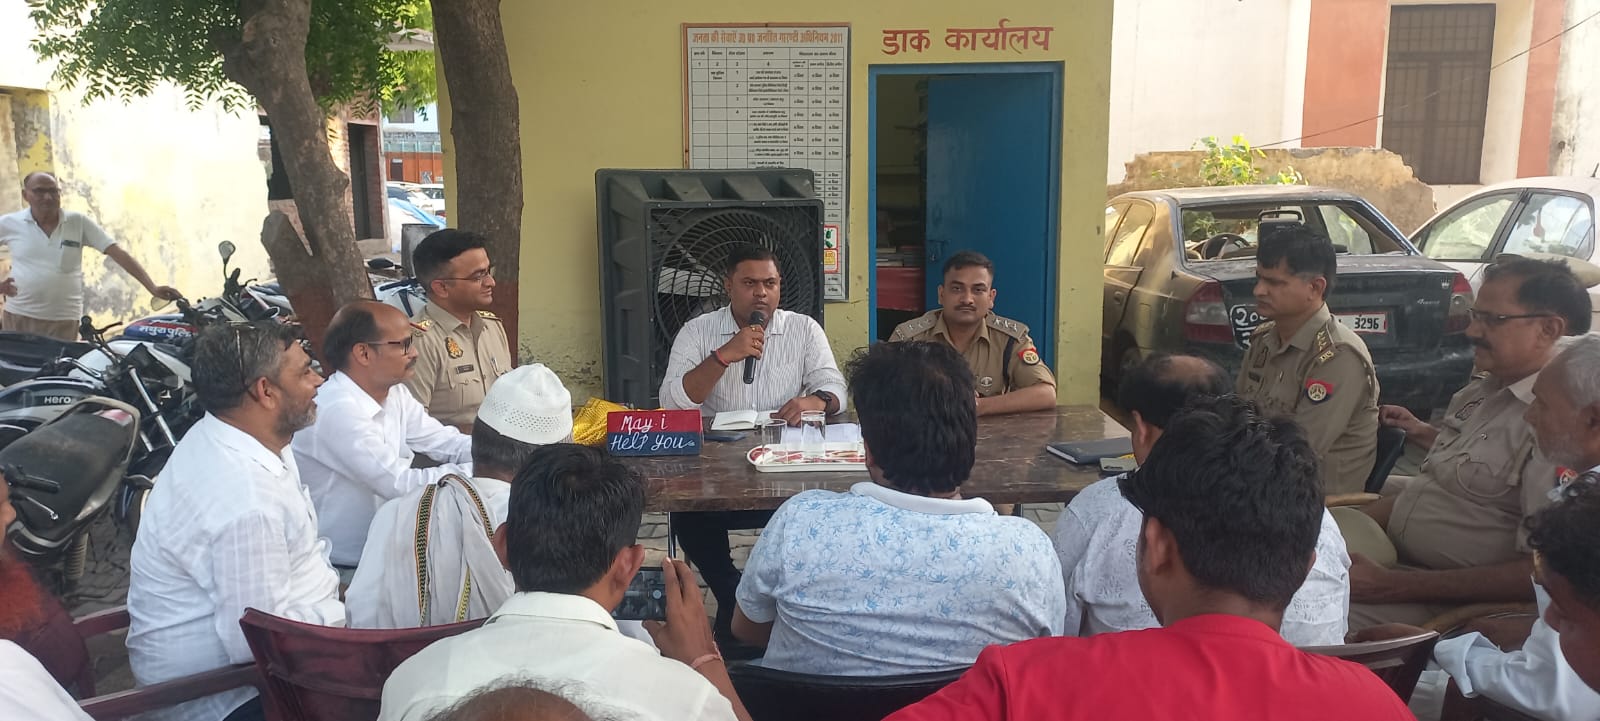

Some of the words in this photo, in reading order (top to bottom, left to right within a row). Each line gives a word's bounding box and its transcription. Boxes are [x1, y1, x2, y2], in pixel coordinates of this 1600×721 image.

[882, 30, 931, 55] डाक
[945, 18, 1054, 54] कार्यालय
[1354, 316, 1380, 330] 3296
[139, 325, 167, 336] मथुरा
